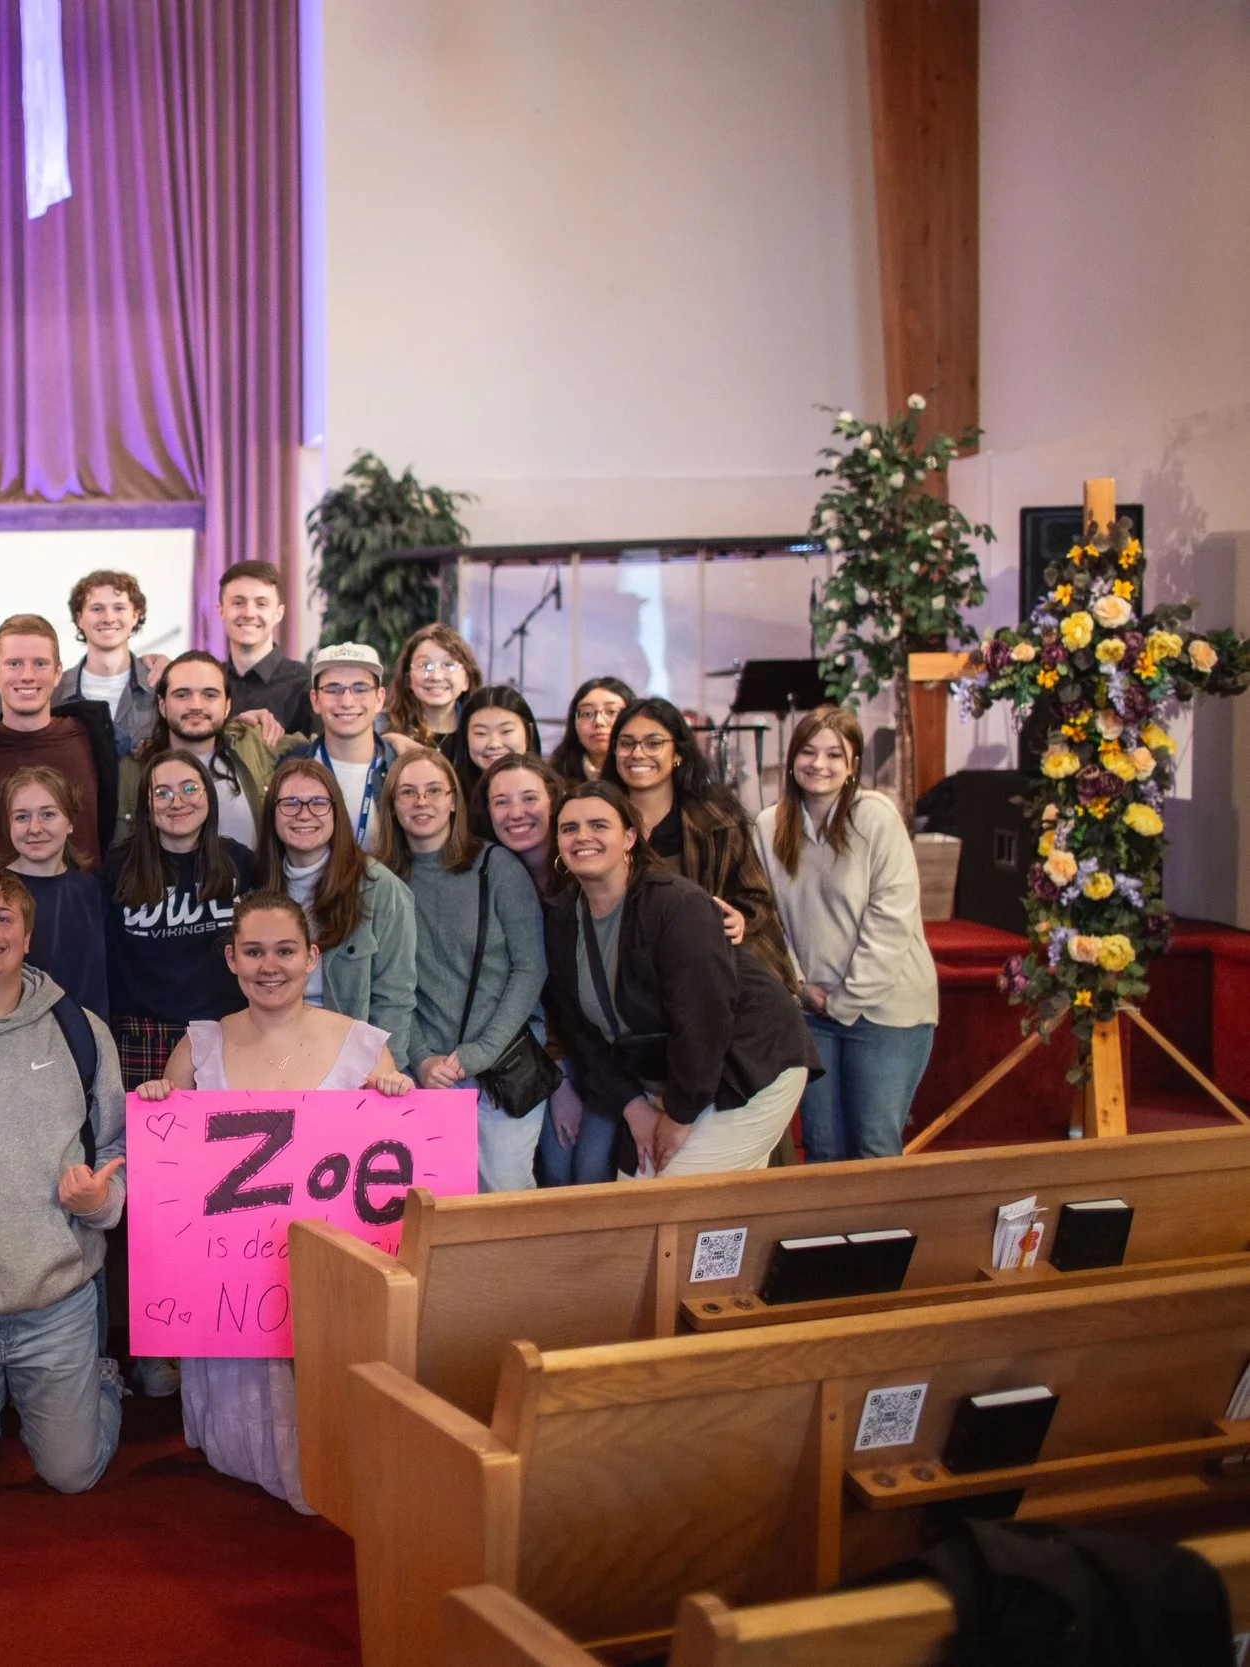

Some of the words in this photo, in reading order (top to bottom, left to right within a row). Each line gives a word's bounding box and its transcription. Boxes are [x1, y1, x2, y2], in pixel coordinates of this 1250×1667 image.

[151, 921, 216, 938] VIKINGS
[203, 1109, 414, 1226] Zoe
[207, 1229, 228, 1258] is
